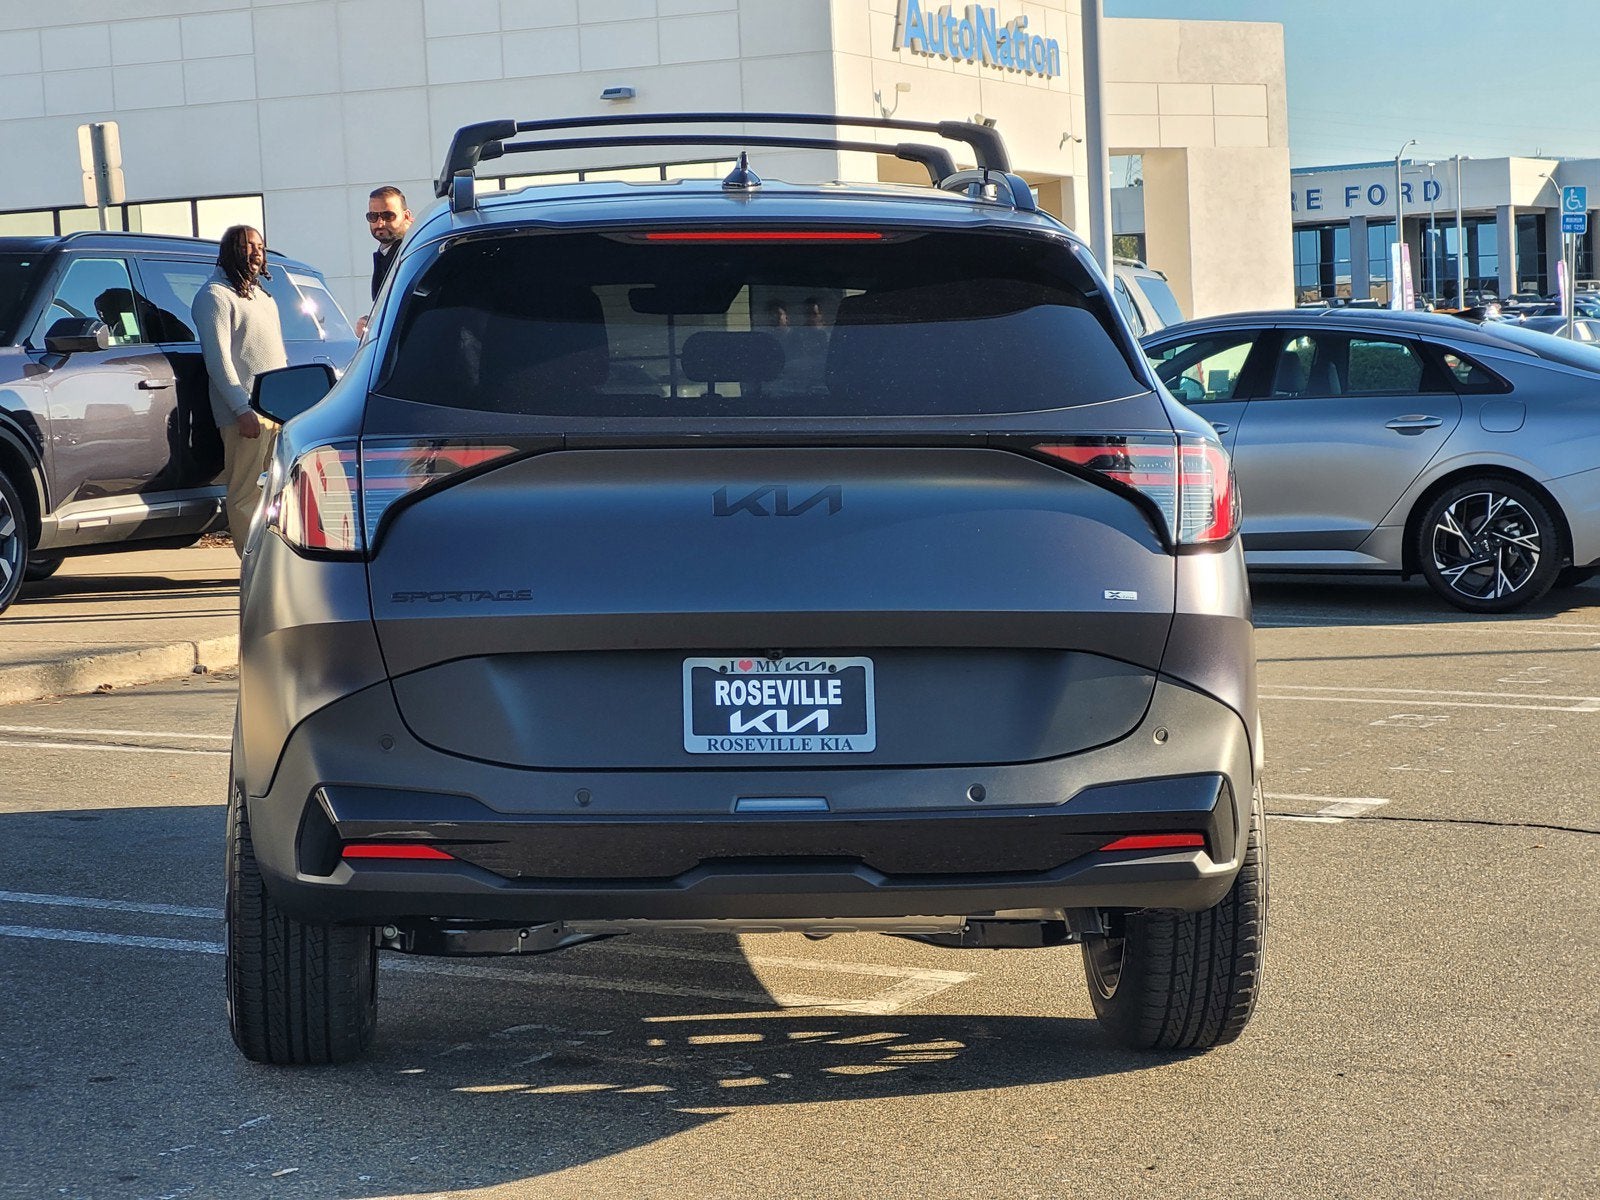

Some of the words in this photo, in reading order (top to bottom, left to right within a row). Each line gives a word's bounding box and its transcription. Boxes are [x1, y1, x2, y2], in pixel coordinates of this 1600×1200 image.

[901, 0, 1061, 77] AutoNation
[1344, 180, 1442, 208] FORD
[712, 484, 844, 517] KIA
[390, 589, 534, 603] SPORTAGE
[729, 660, 736, 673] I
[756, 660, 783, 673] MY
[785, 661, 827, 672] KIA
[714, 679, 843, 706] ROSEVILLE
[729, 709, 829, 733] KIA
[707, 737, 813, 752] ROSEVILLE
[820, 737, 854, 751] KIA
